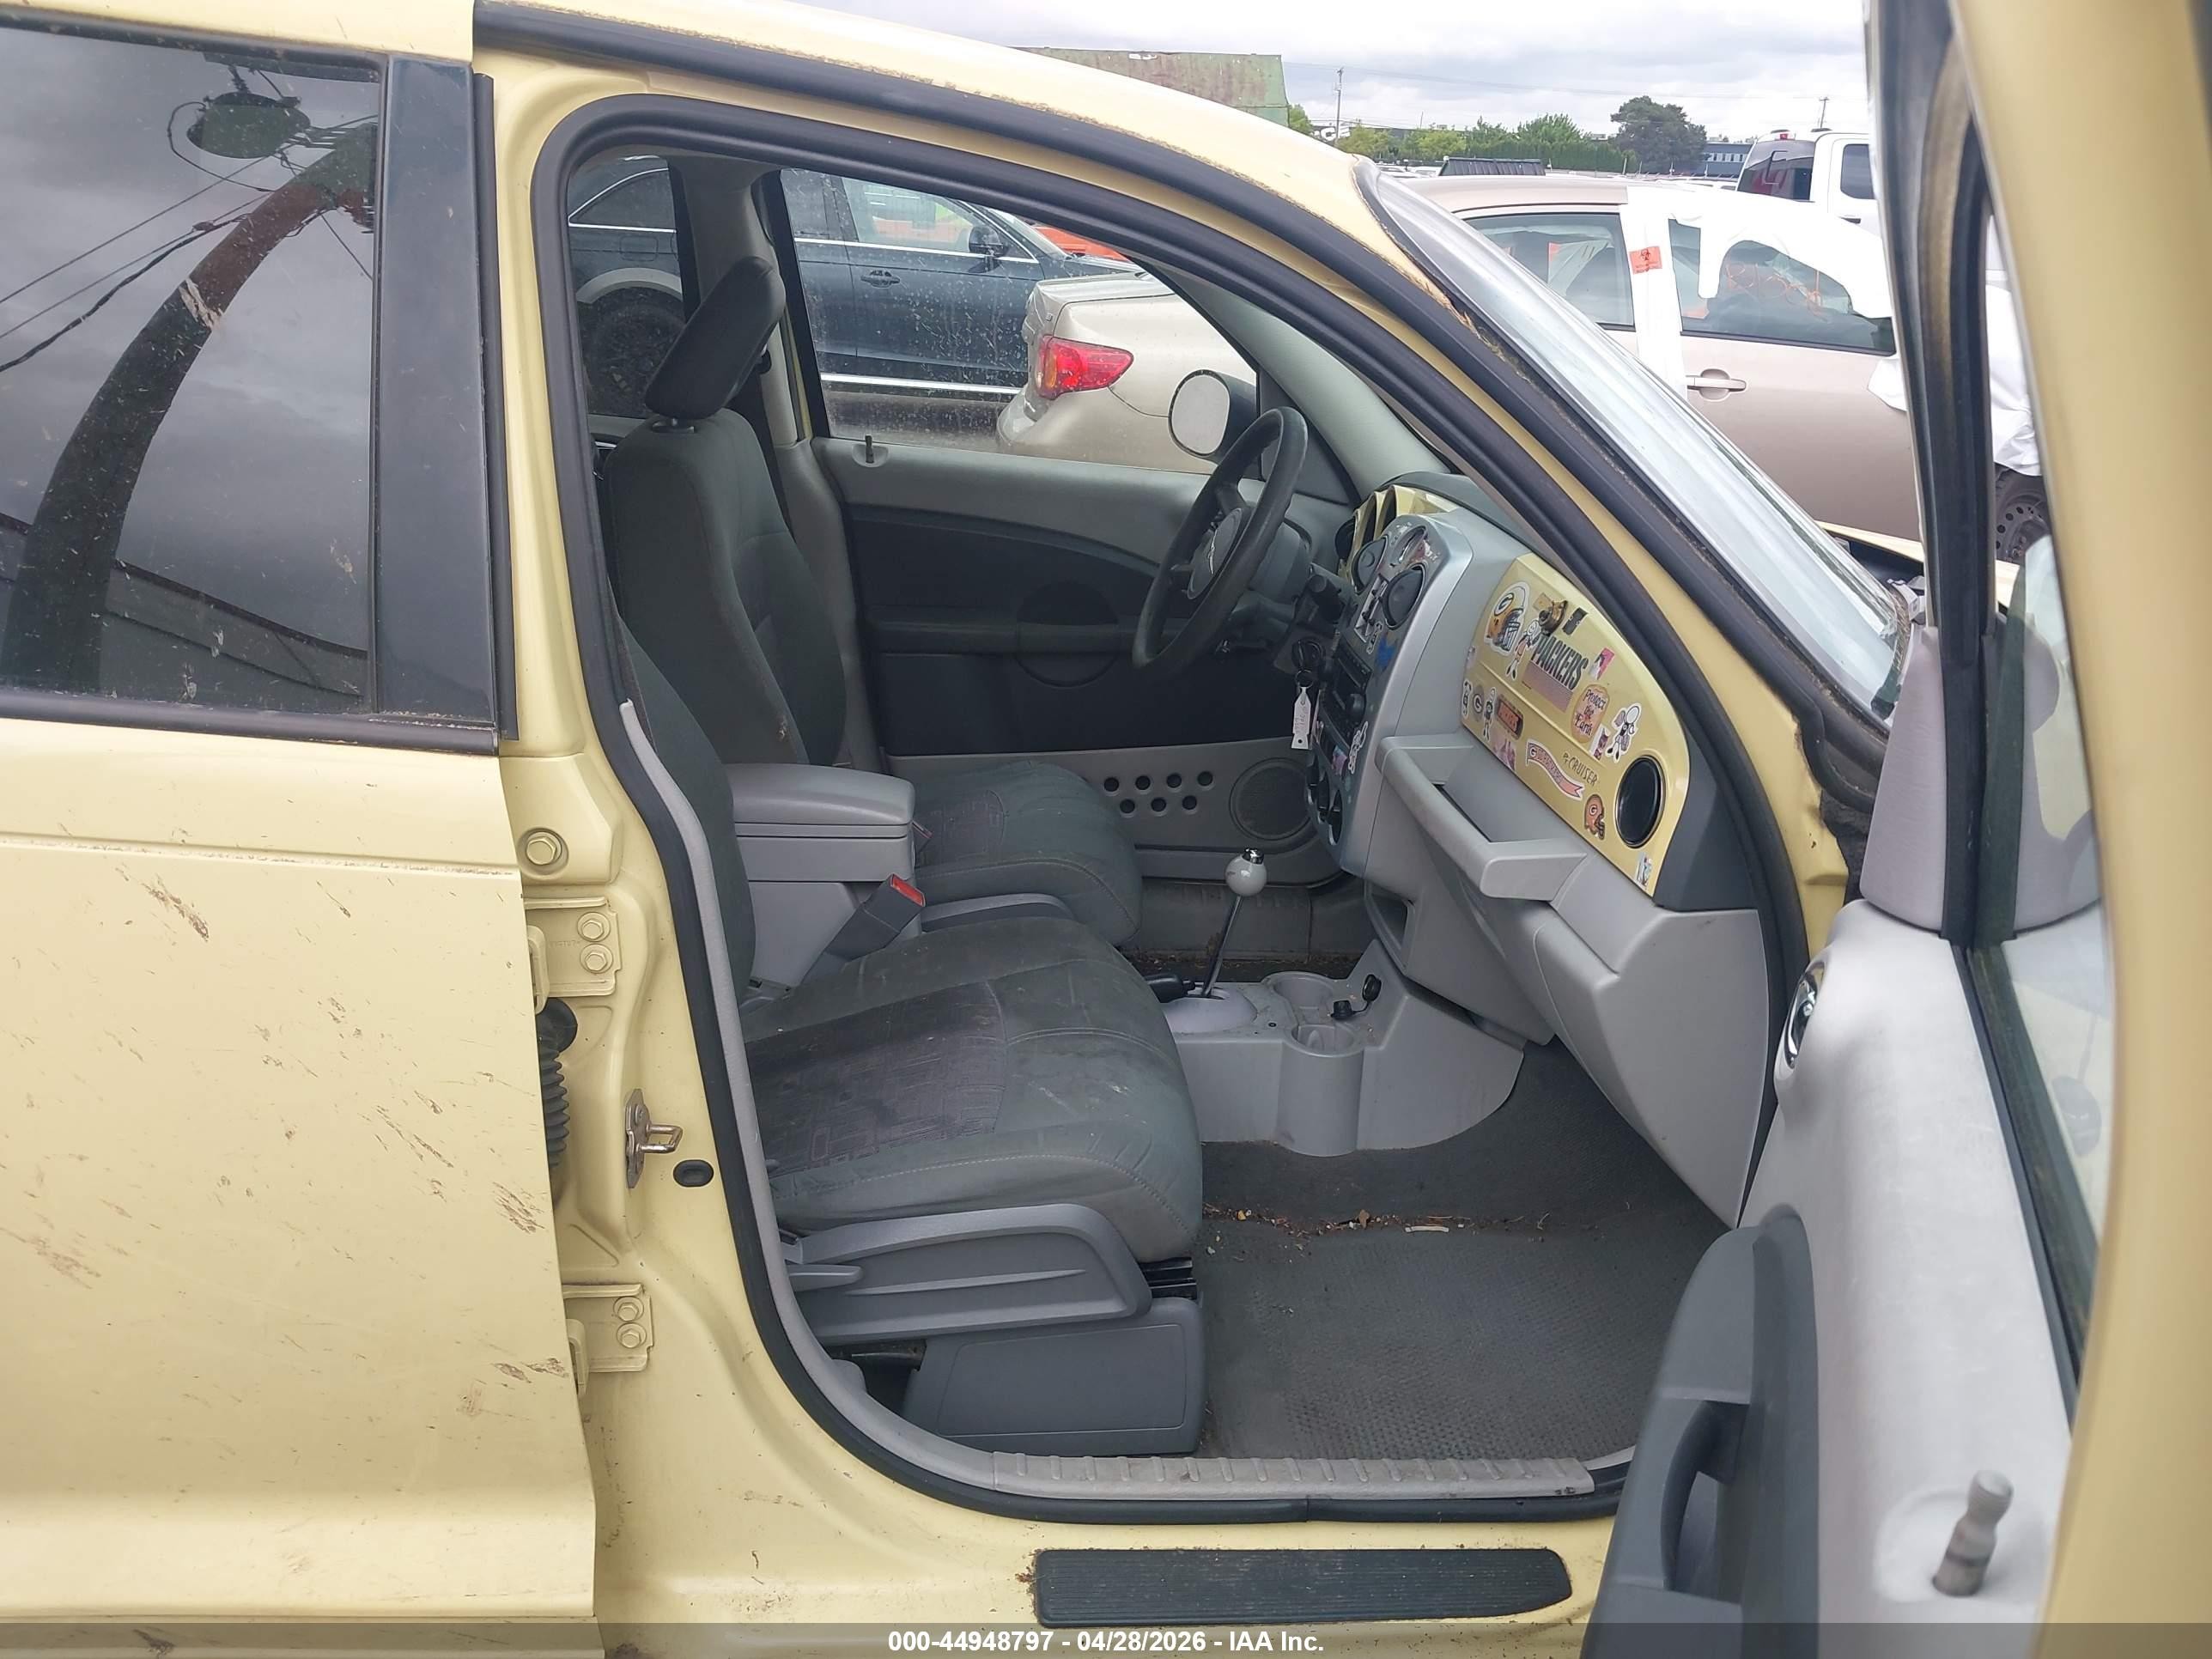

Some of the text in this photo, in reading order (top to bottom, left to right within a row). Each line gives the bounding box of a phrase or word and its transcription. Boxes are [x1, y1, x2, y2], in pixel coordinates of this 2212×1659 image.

[1530, 633, 1589, 690] PACKERS
[1583, 689, 1606, 710] Protect
[1569, 757, 1598, 786] CRUISER
